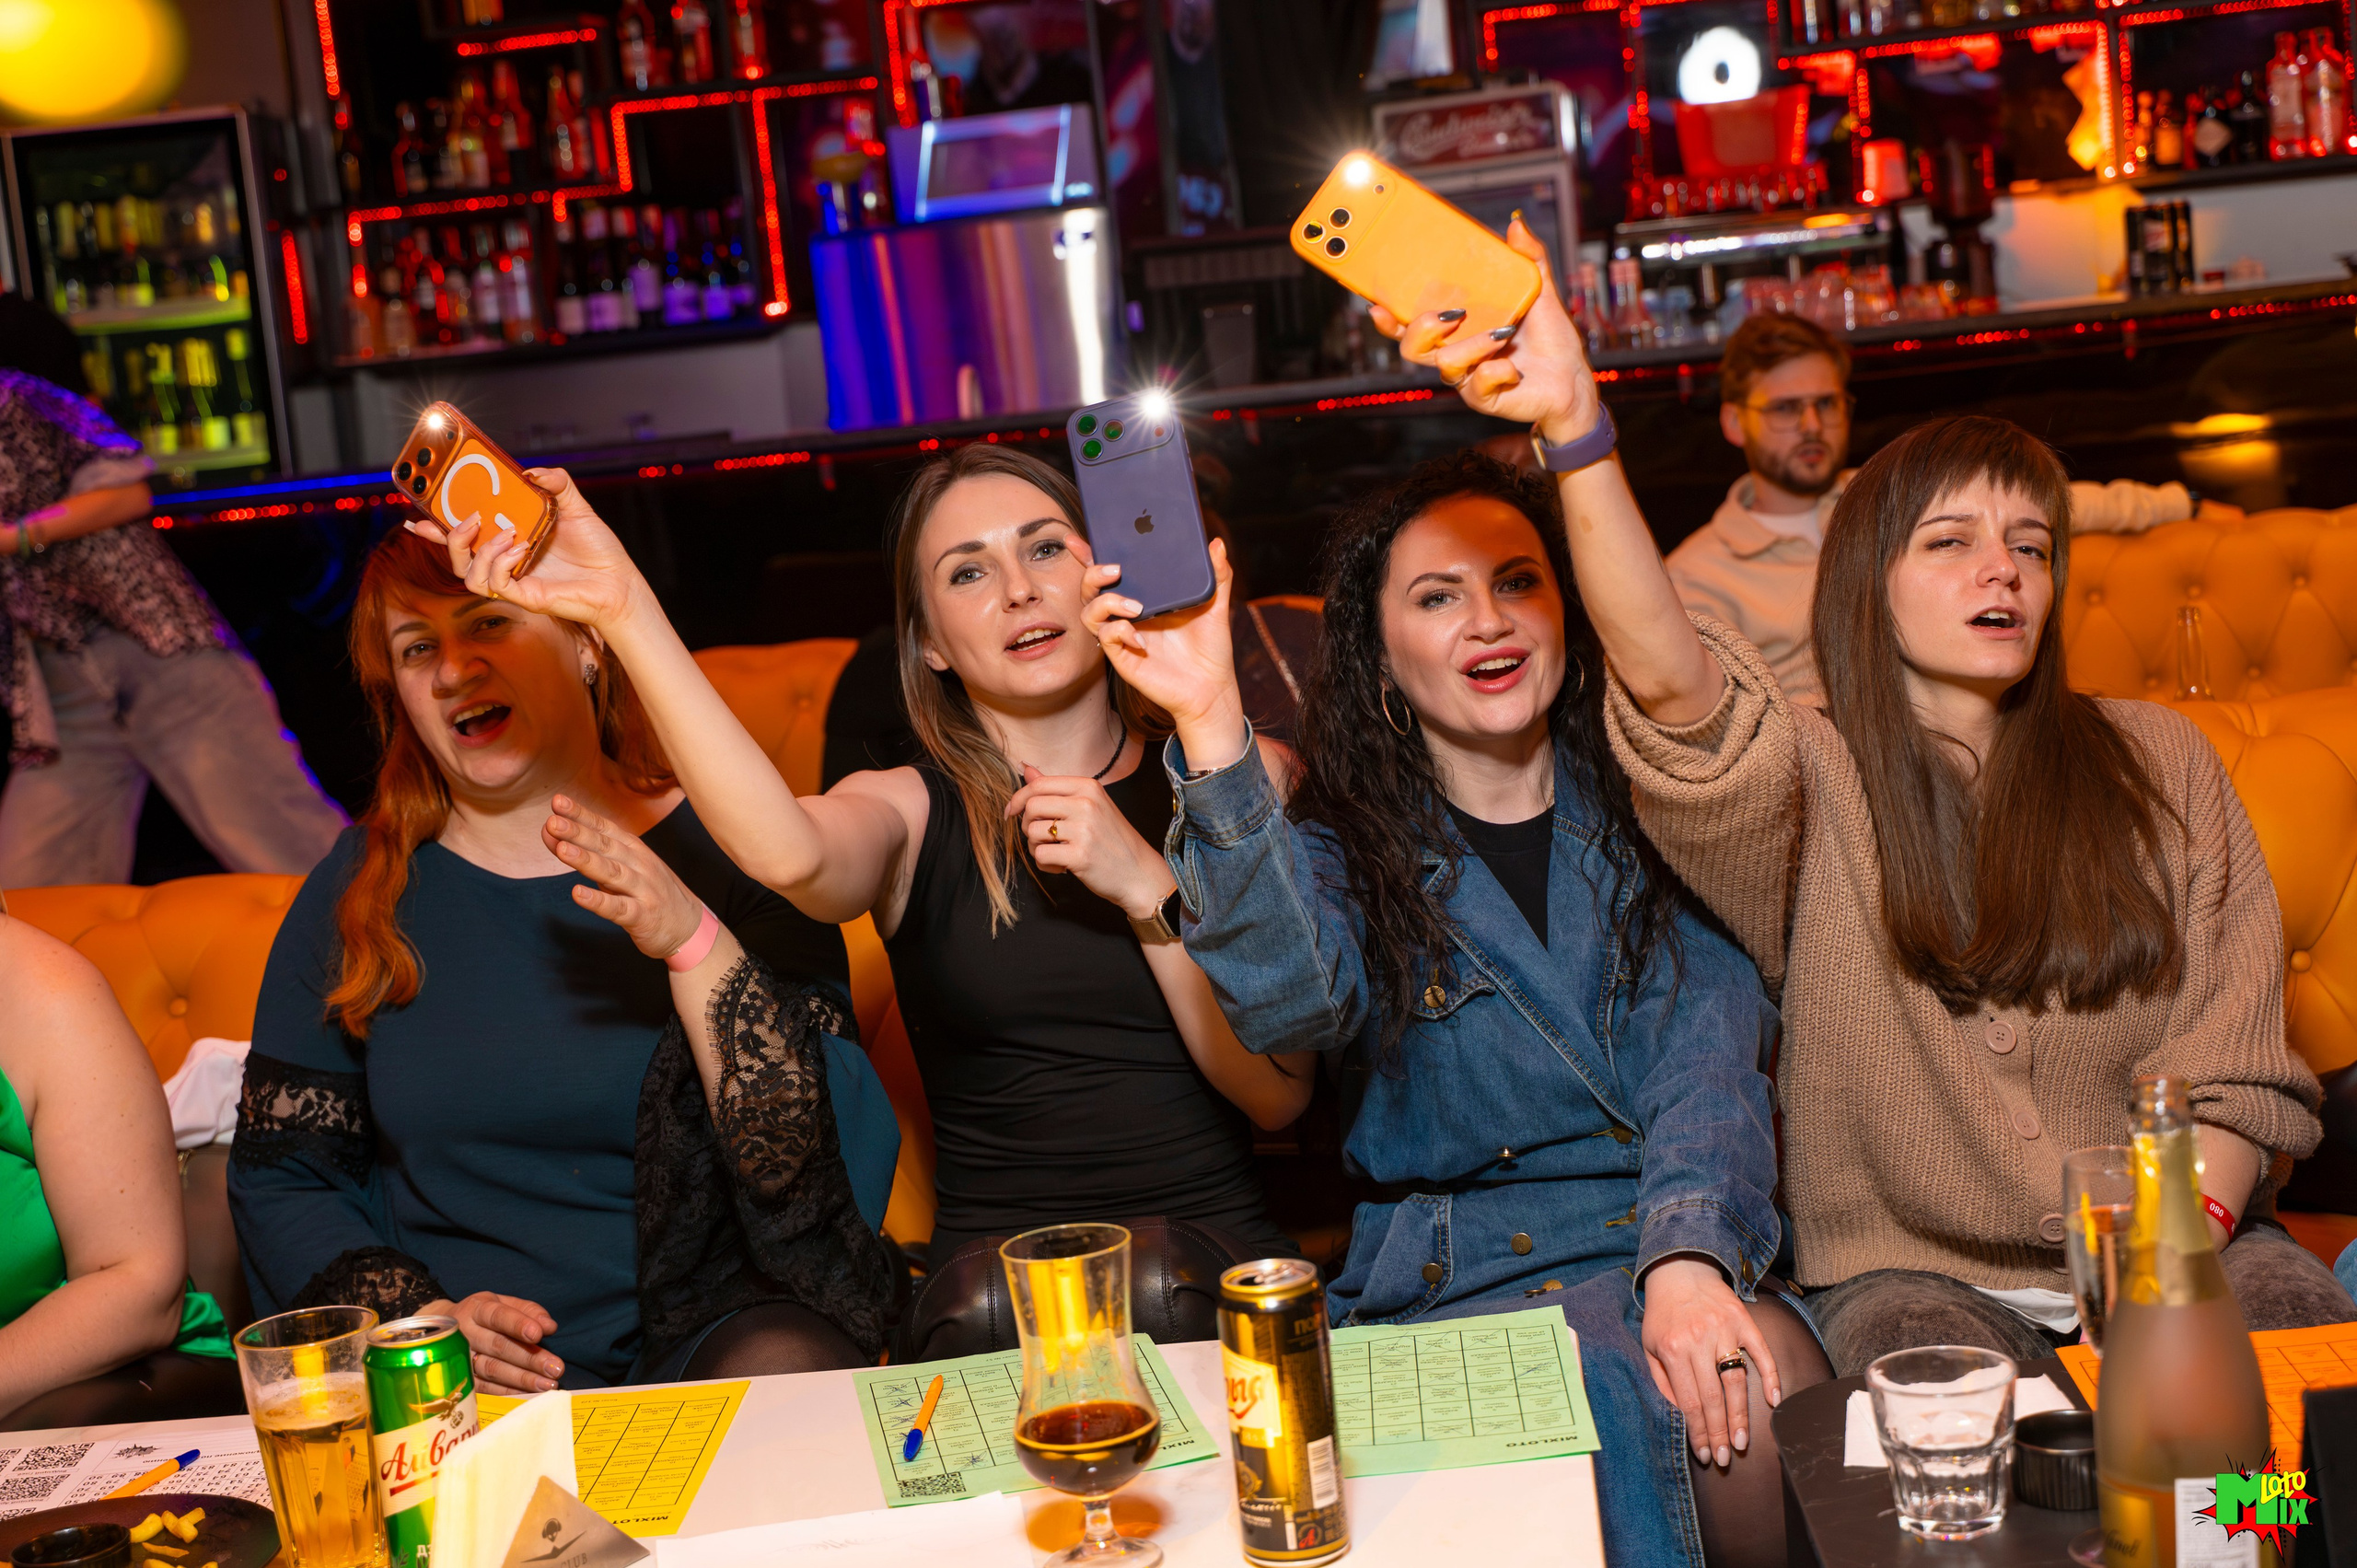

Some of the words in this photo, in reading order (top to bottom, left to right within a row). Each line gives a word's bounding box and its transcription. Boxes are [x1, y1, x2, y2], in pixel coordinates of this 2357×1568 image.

[2209, 1202, 2224, 1217] 080
[1157, 1438, 1195, 1452] MIXL
[1506, 1435, 1578, 1447] MIXLOTO
